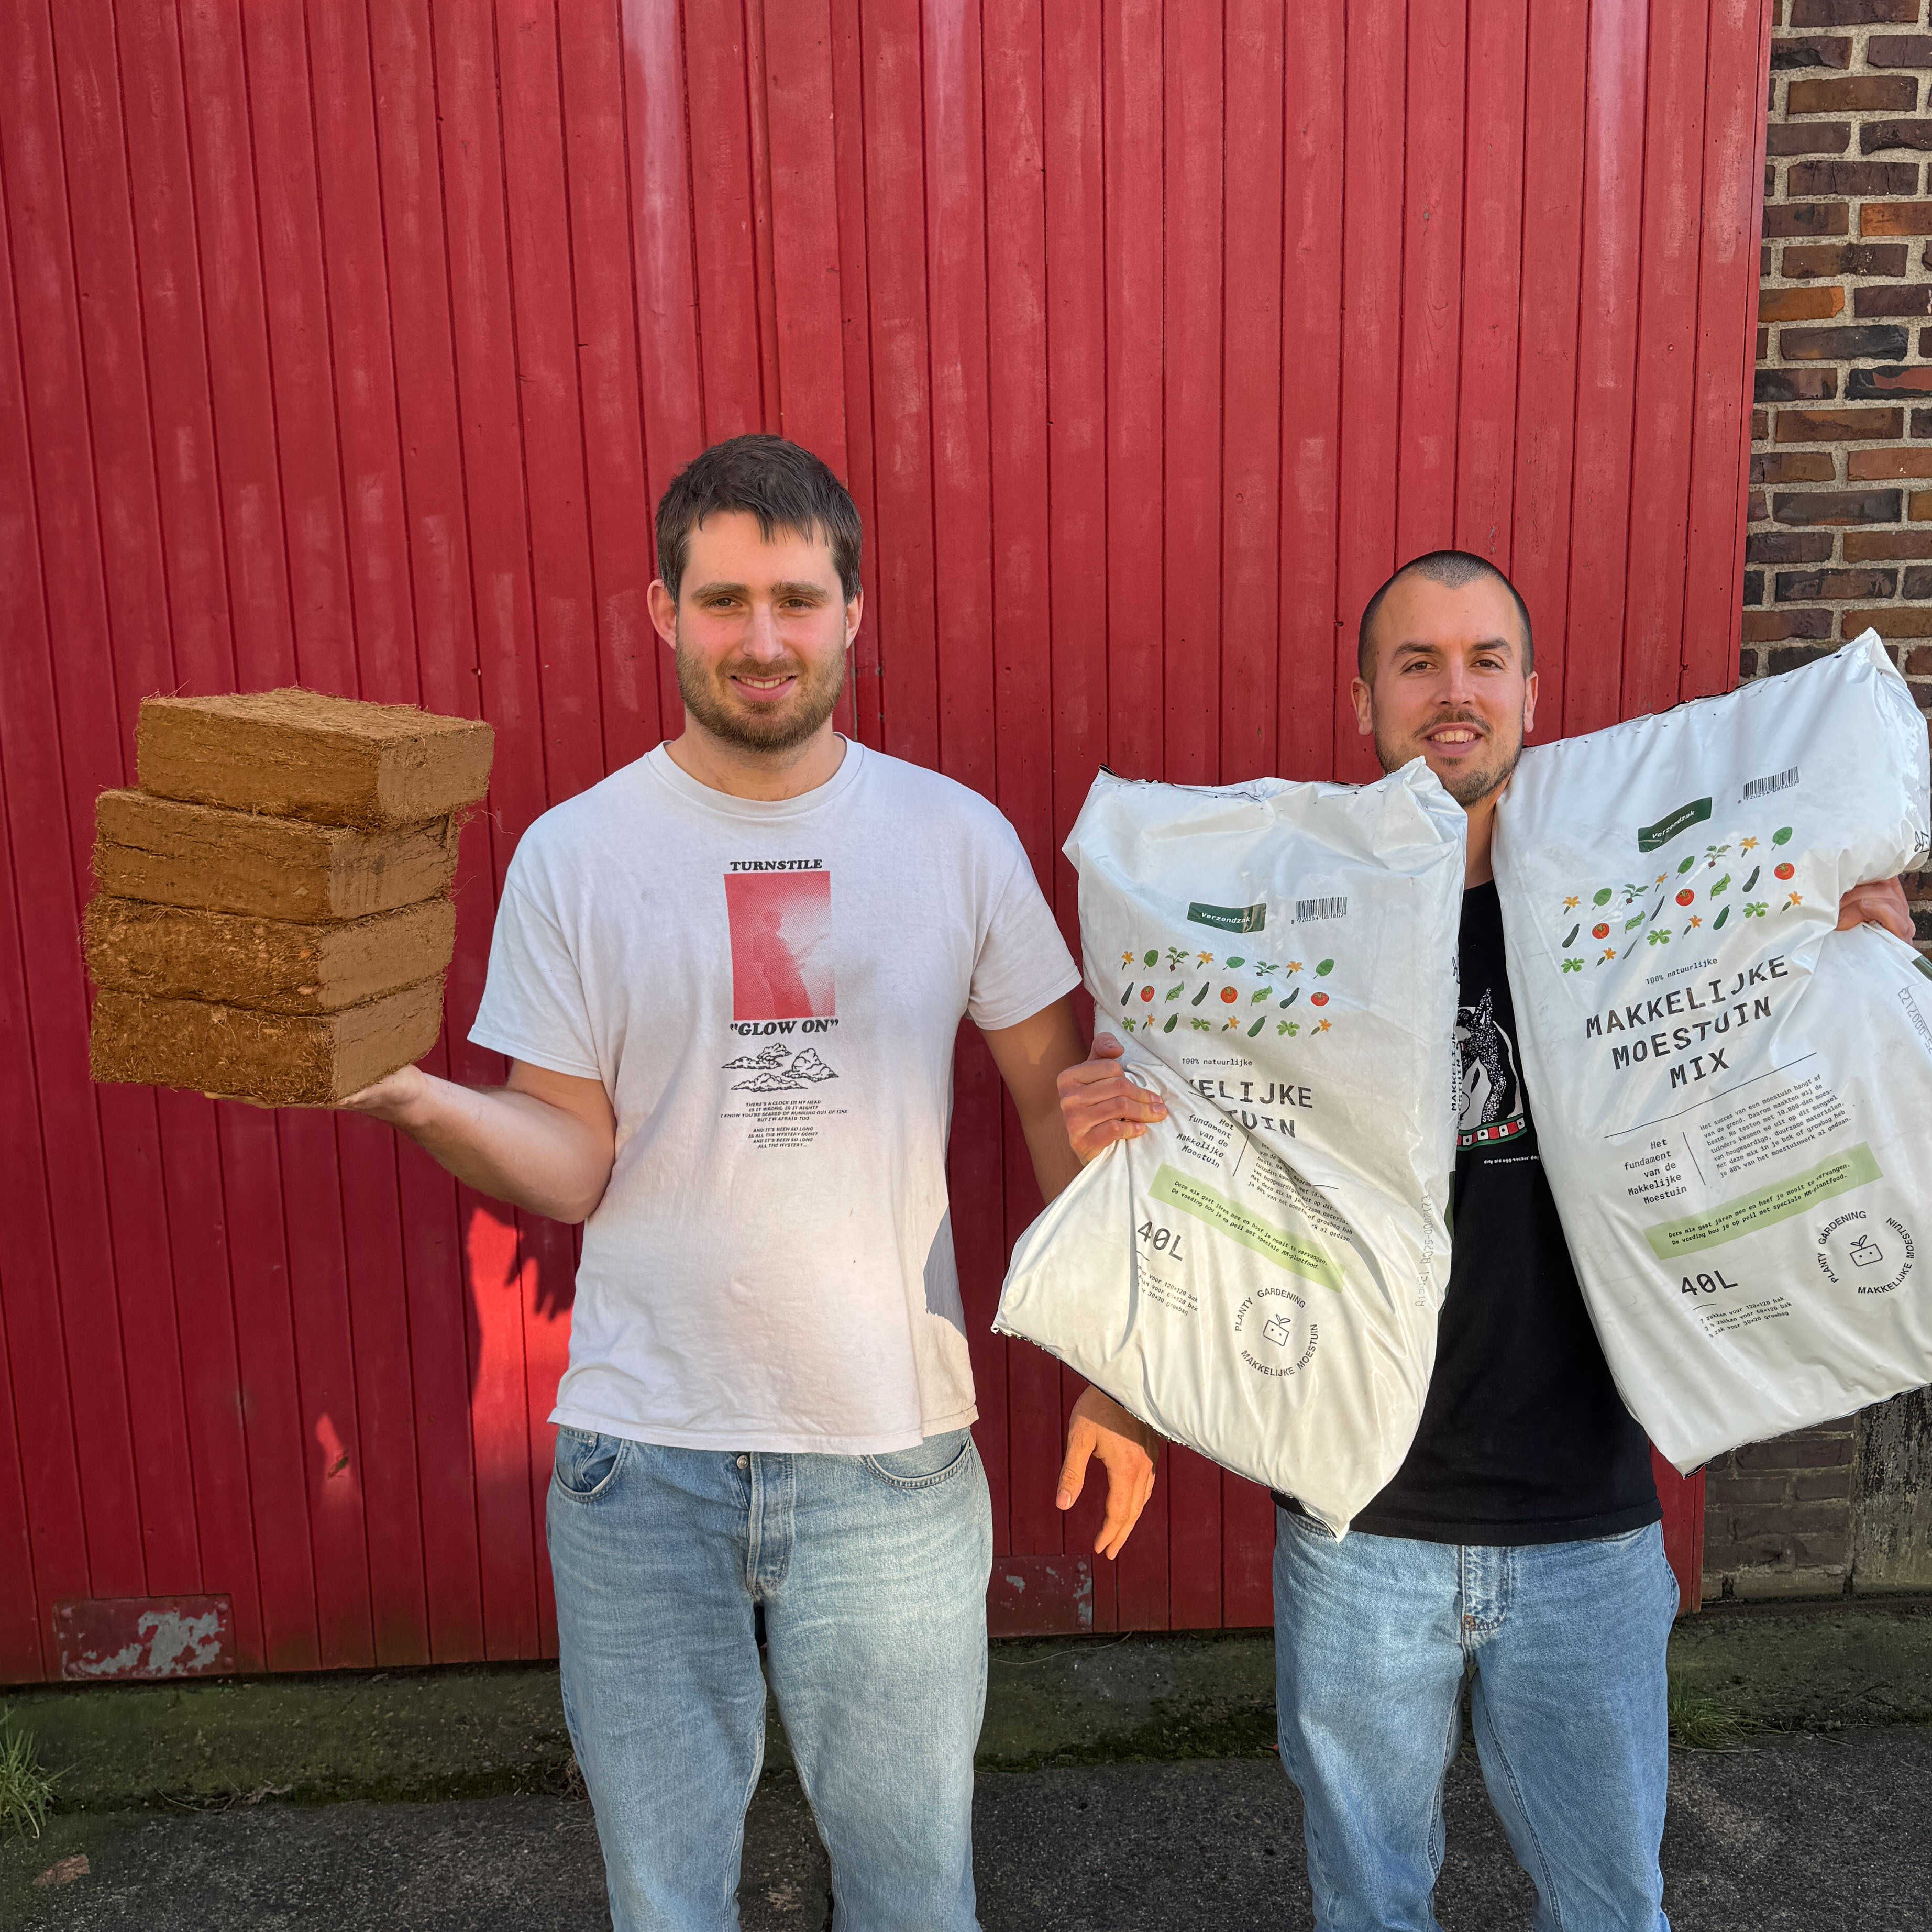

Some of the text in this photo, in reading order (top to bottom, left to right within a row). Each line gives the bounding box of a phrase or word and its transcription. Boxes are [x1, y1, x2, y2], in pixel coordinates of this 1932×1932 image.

[1652, 811, 1696, 838] verzendzak
[730, 859, 822, 871] TURNSTILE
[1646, 959, 1717, 984] 100% natuurlijke
[1587, 955, 1788, 1038] MAKKELIJKE
[1612, 996, 1771, 1070] MOESTUIN
[1204, 1058, 1252, 1067] natuurlijke
[1670, 1048, 1729, 1088] MIX
[1189, 1079, 1313, 1108] ELIJKE
[1793, 1079, 1812, 1090] hangt
[1189, 1114, 1233, 1139] fundament
[1219, 1119, 1234, 1130] Het
[1834, 1110, 1845, 1119] heb
[1176, 1133, 1224, 1158] Makkelijke
[1200, 1131, 1214, 1141] van
[1651, 1139, 1667, 1149] Het
[1182, 1145, 1222, 1168] Moestuin
[1624, 1151, 1671, 1170] fundament
[1644, 1163, 1676, 1177] van de
[1628, 1175, 1681, 1195] Makkelijke
[1643, 1187, 1686, 1204] Moestuin
[1698, 1222, 1712, 1231] gaat
[1759, 1196, 1772, 1206] hoef
[1742, 1212, 1757, 1222] peil
[1138, 1221, 1183, 1261] 40L
[1817, 1211, 1867, 1283] PLANTY GARDENING
[1858, 1217, 1915, 1294] MAKKELIJKE MOESTUIN
[1682, 1270, 1738, 1295] 40L
[1235, 1288, 1306, 1332] PLANTY GARDENING
[1241, 1324, 1318, 1377] MAKKELIJKE MOESTUIN
